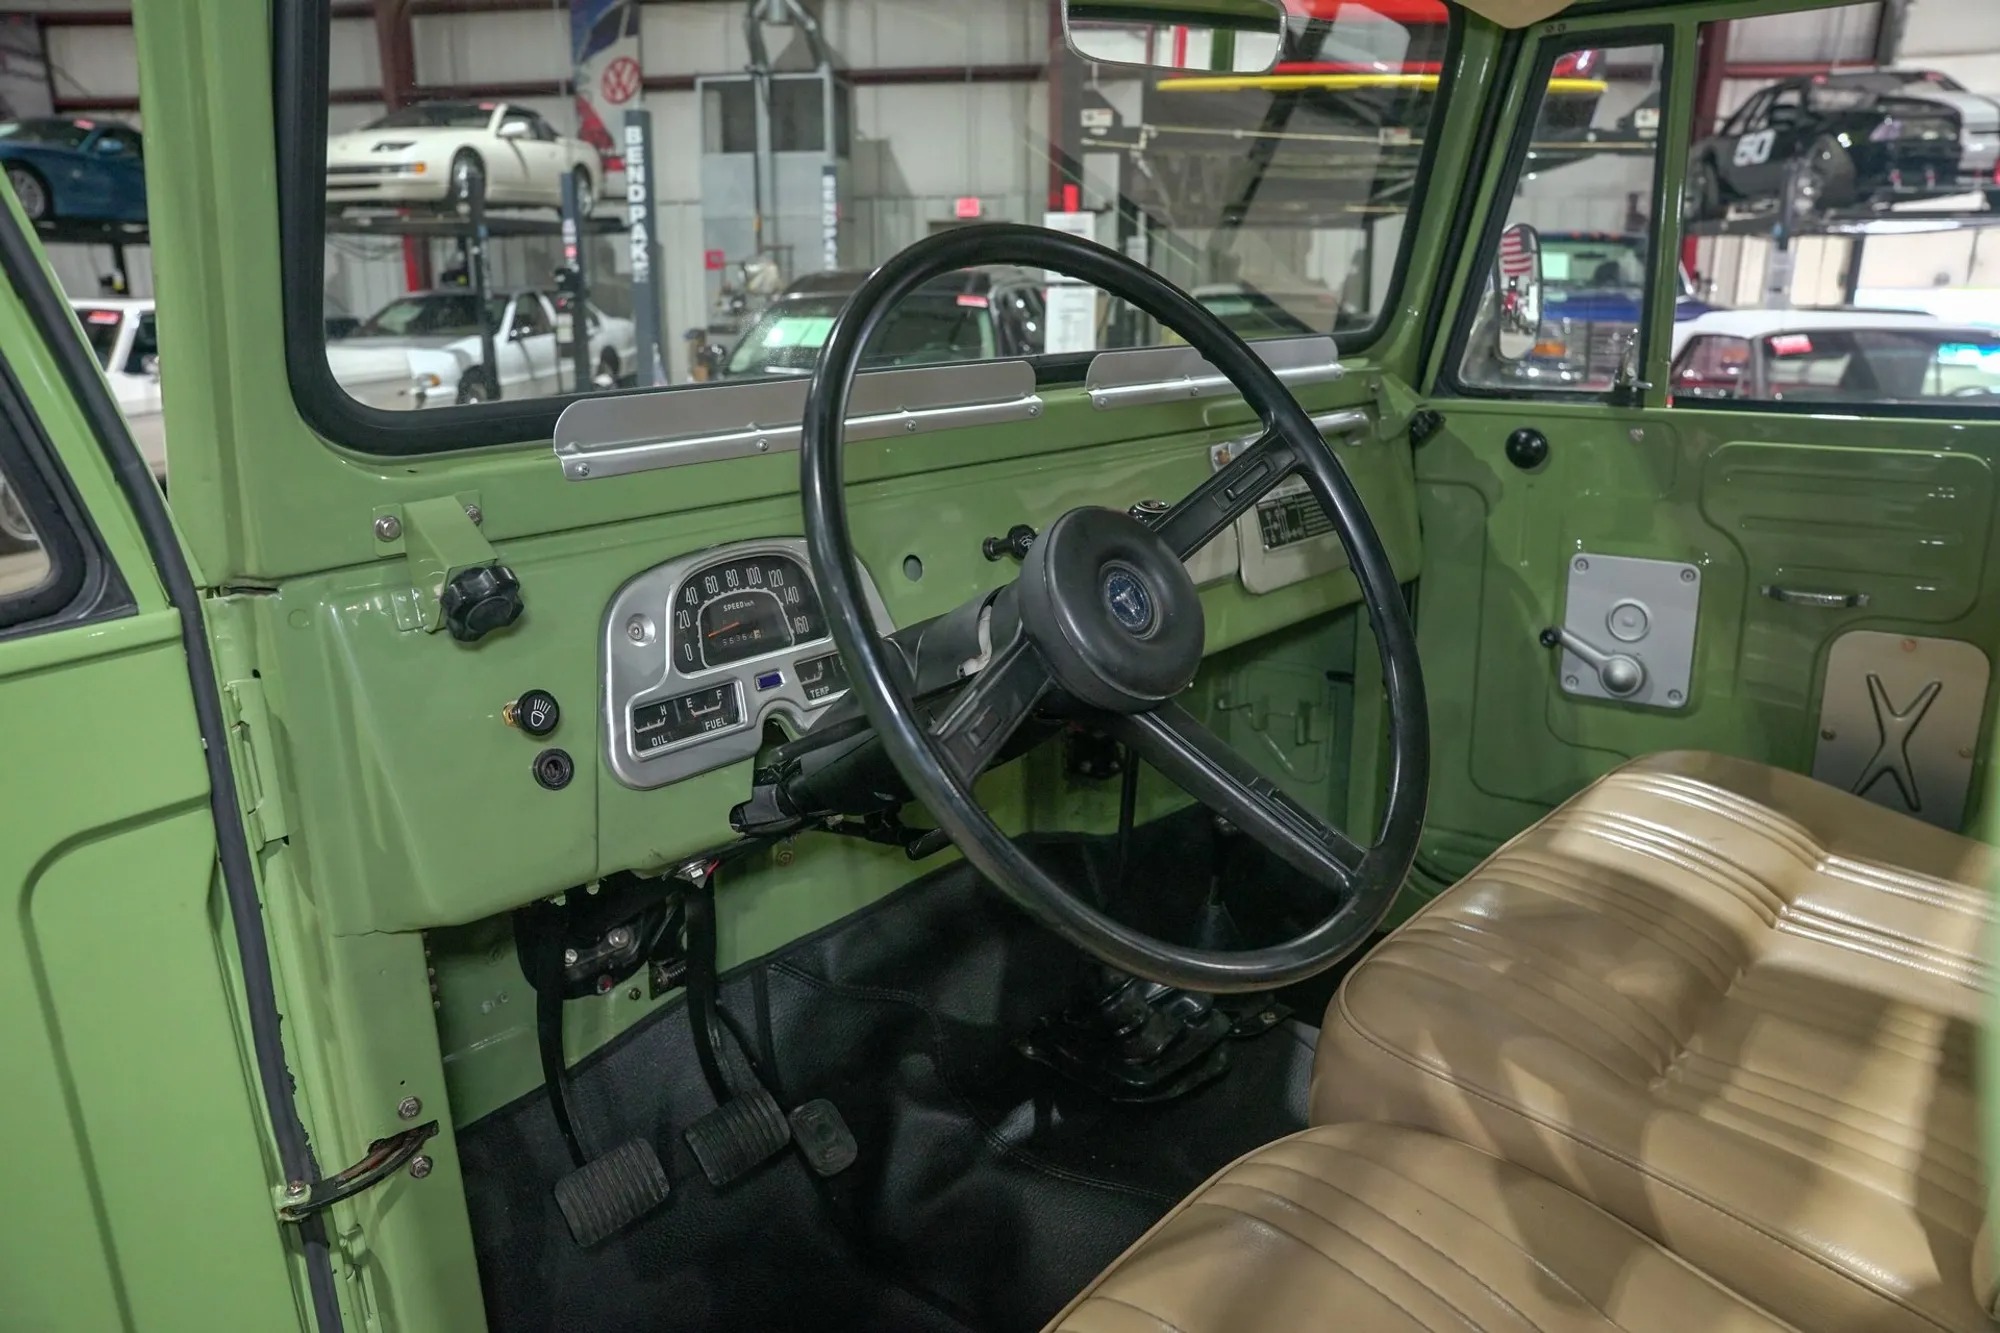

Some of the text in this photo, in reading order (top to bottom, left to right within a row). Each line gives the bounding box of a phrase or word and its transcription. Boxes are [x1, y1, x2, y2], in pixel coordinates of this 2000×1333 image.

[704, 575, 719, 594] 60
[725, 568, 740, 588] 80
[746, 566, 762, 586] 100
[768, 568, 784, 588] 120
[685, 586, 699, 606] 40
[783, 585, 800, 605] 140
[723, 600, 744, 612] SPEED
[676, 609, 691, 630] 20
[793, 615, 810, 635] 160
[684, 643, 693, 662] 0
[816, 660, 824, 672] H
[716, 689, 723, 701] F
[809, 686, 830, 699] TEMP
[660, 705, 668, 716] H
[686, 697, 693, 708] E
[704, 717, 728, 732] FUEL
[651, 735, 668, 747] OIL
